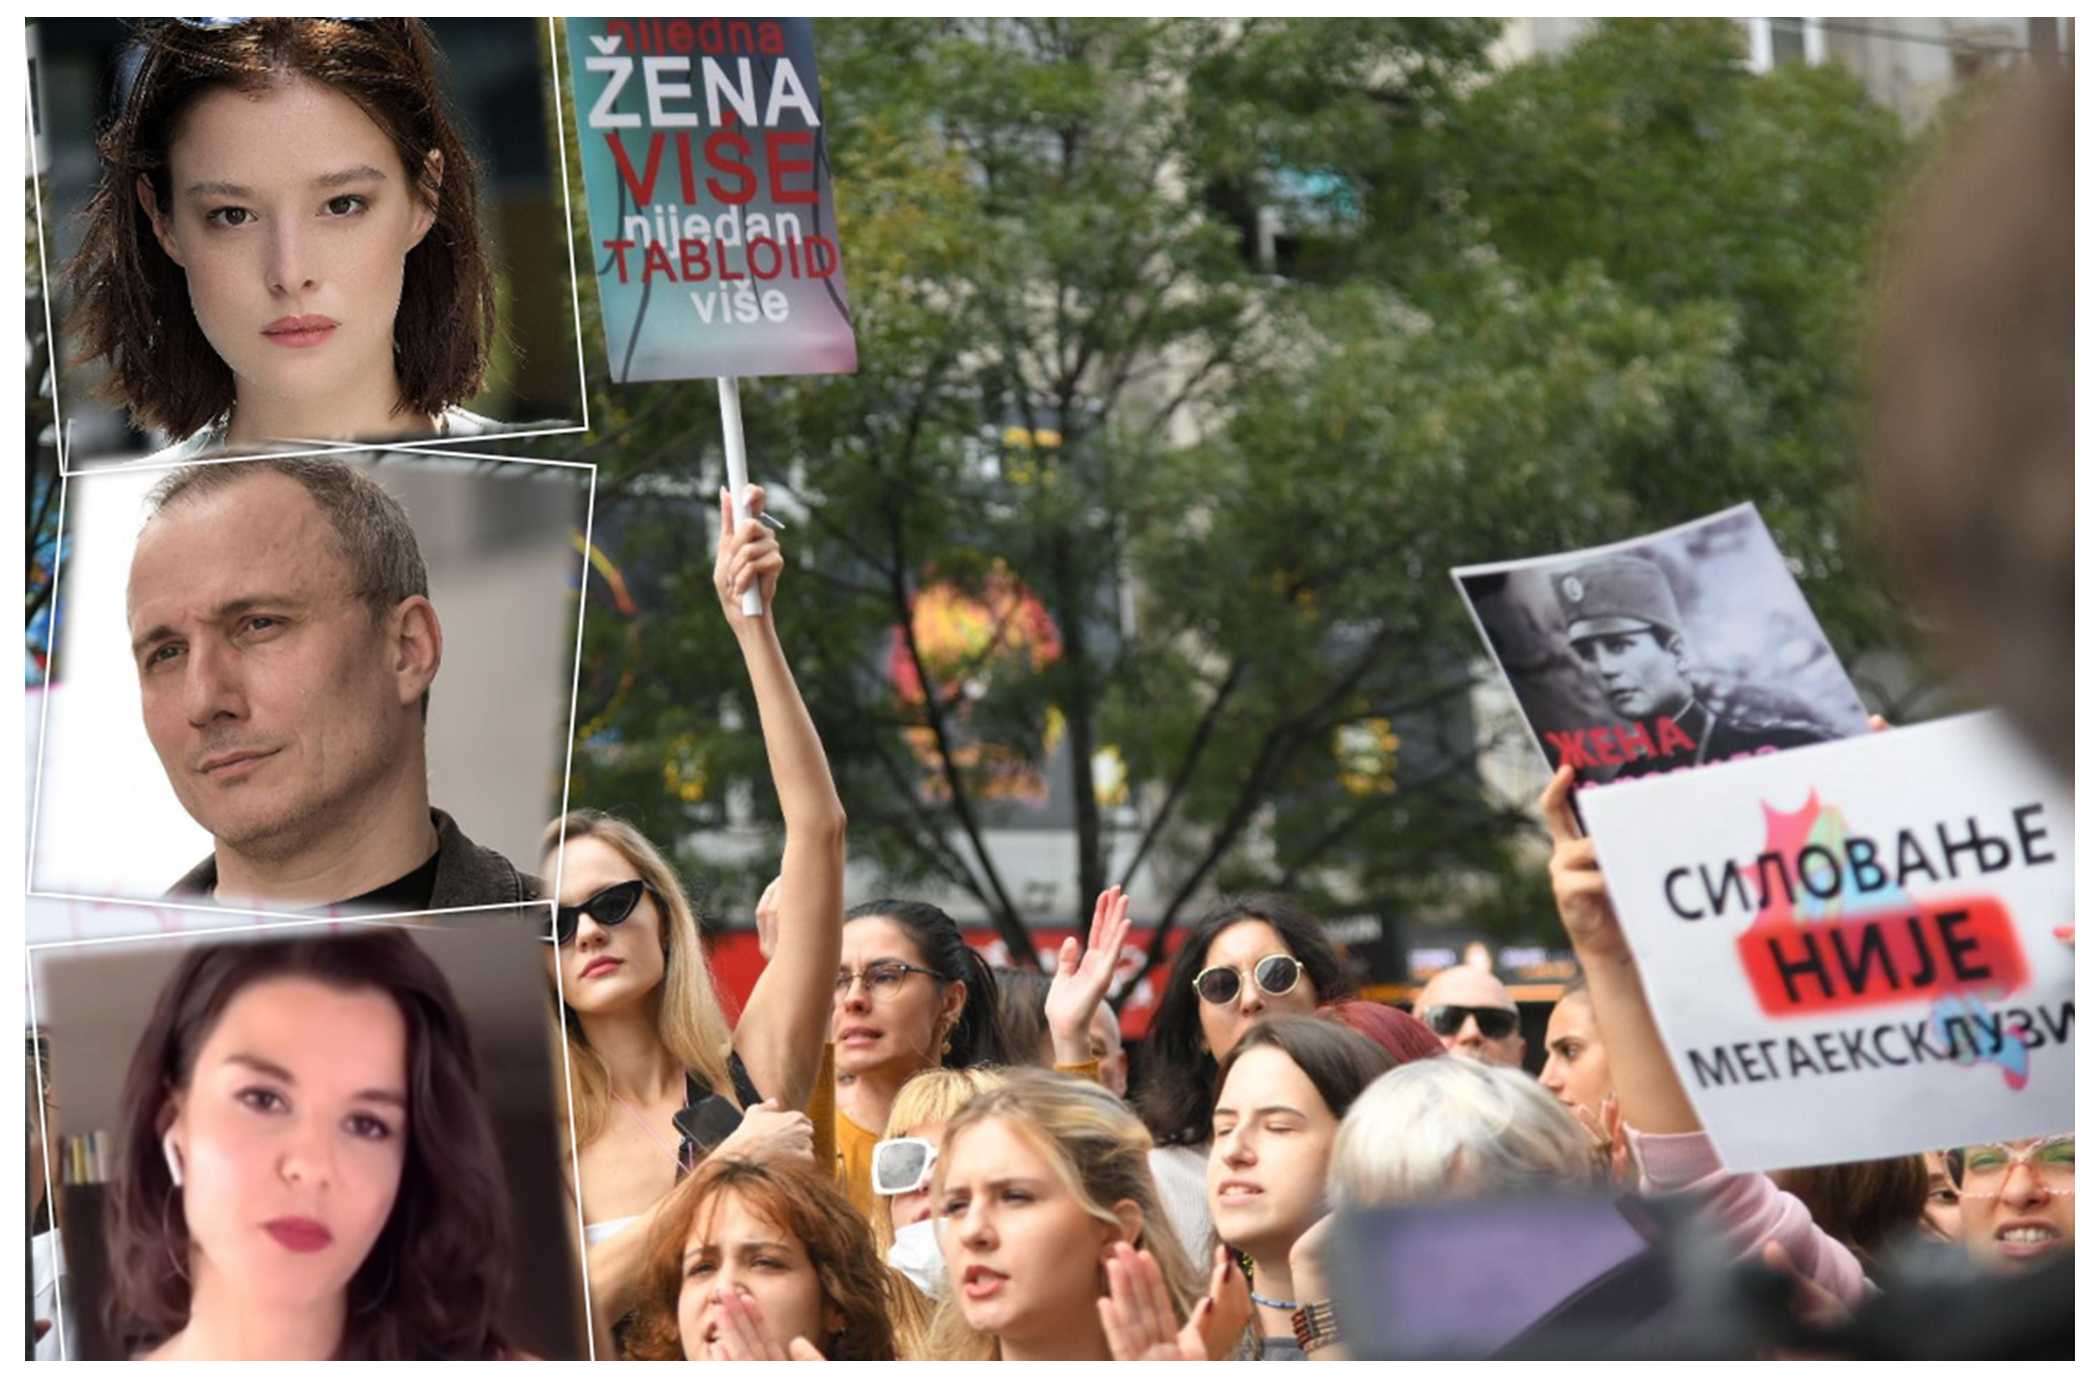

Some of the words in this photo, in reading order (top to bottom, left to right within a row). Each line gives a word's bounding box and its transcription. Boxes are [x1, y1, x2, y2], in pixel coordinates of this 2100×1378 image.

[607, 17, 785, 56] nijedna
[585, 35, 820, 128] ŽENA
[604, 109, 819, 206] VIŠE
[603, 235, 838, 284] TABLOID
[624, 204, 801, 260] nijedan
[690, 279, 789, 324] više
[1546, 716, 1697, 768] ЖЕНА
[1663, 803, 2056, 921] СИЛОВАЊЕ
[1768, 910, 1991, 1004] НИЈЕ
